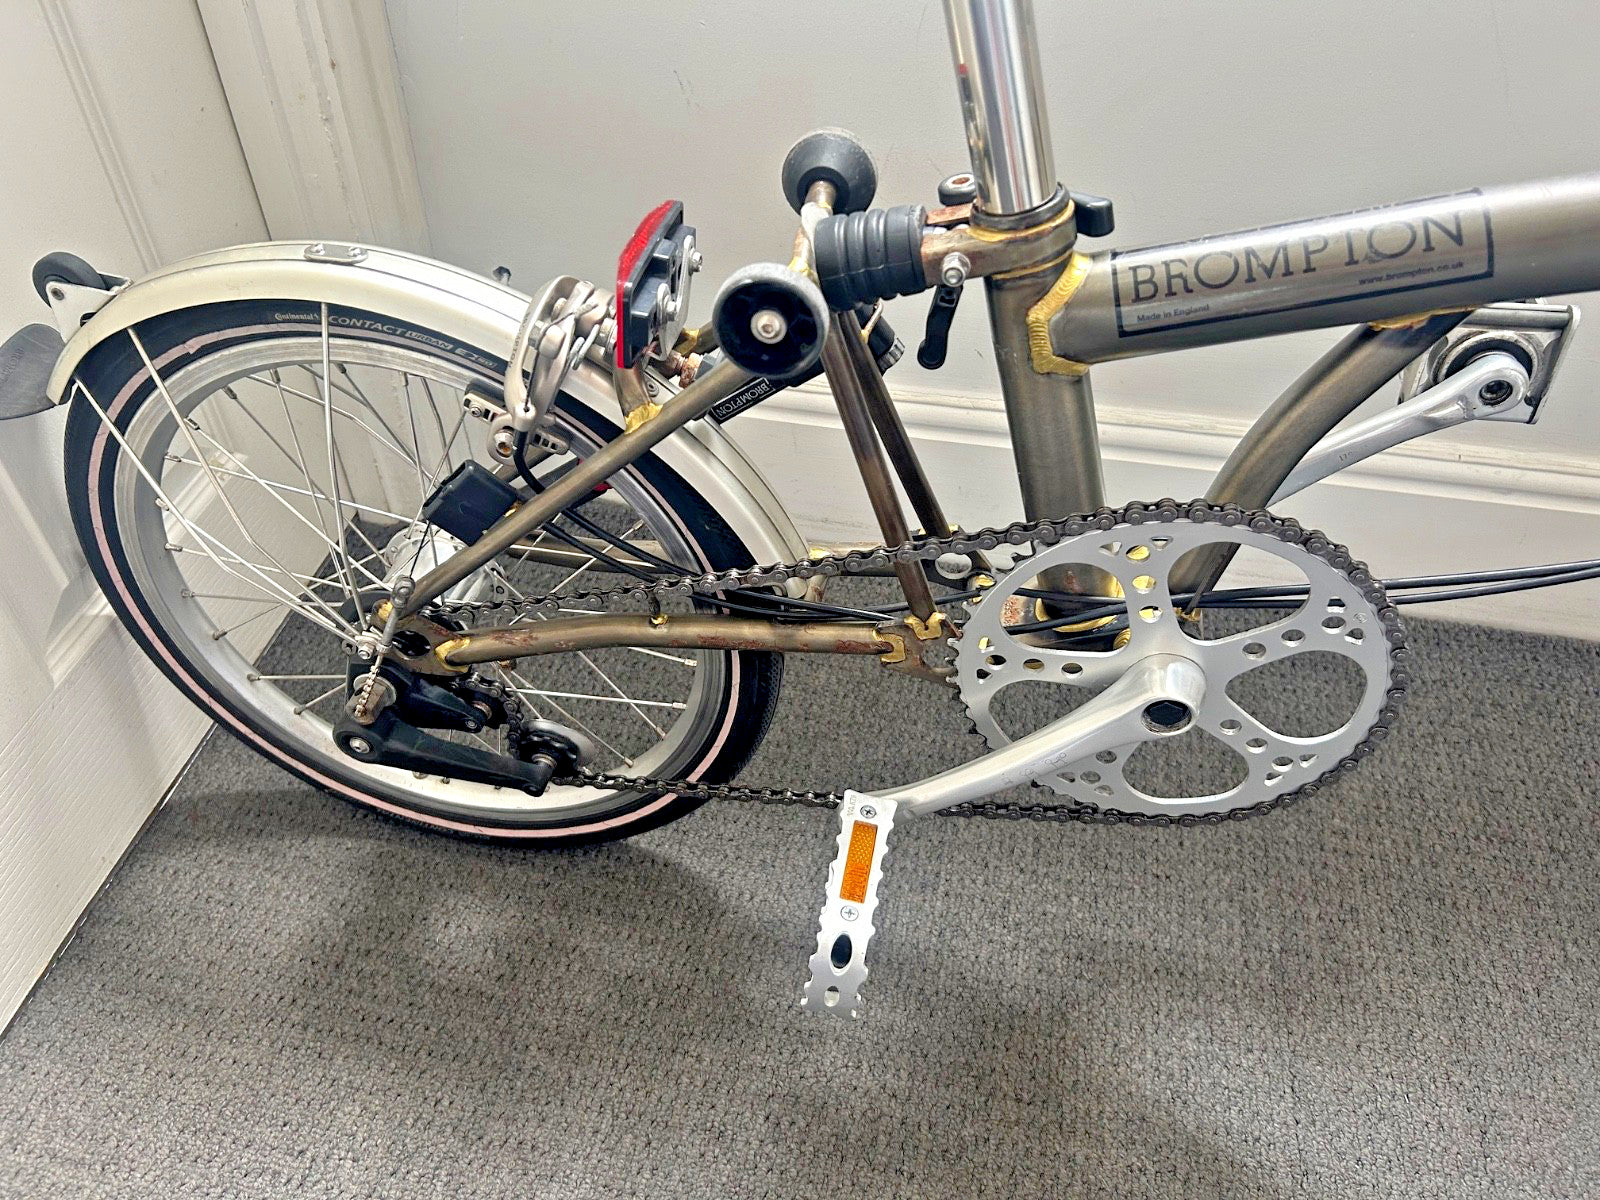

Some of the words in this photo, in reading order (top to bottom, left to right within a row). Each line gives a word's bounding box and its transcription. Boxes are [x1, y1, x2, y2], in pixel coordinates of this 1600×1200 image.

[1128, 211, 1465, 303] BROMPTON
[1358, 260, 1465, 285] www.brompton.co.uk
[1137, 312, 1161, 323] Made
[1162, 311, 1172, 319] in
[1173, 304, 1210, 317] England
[275, 310, 316, 321] Continental
[328, 317, 406, 336] CONTACT
[405, 330, 454, 351] URBAN
[716, 383, 770, 416] BROMPTON
